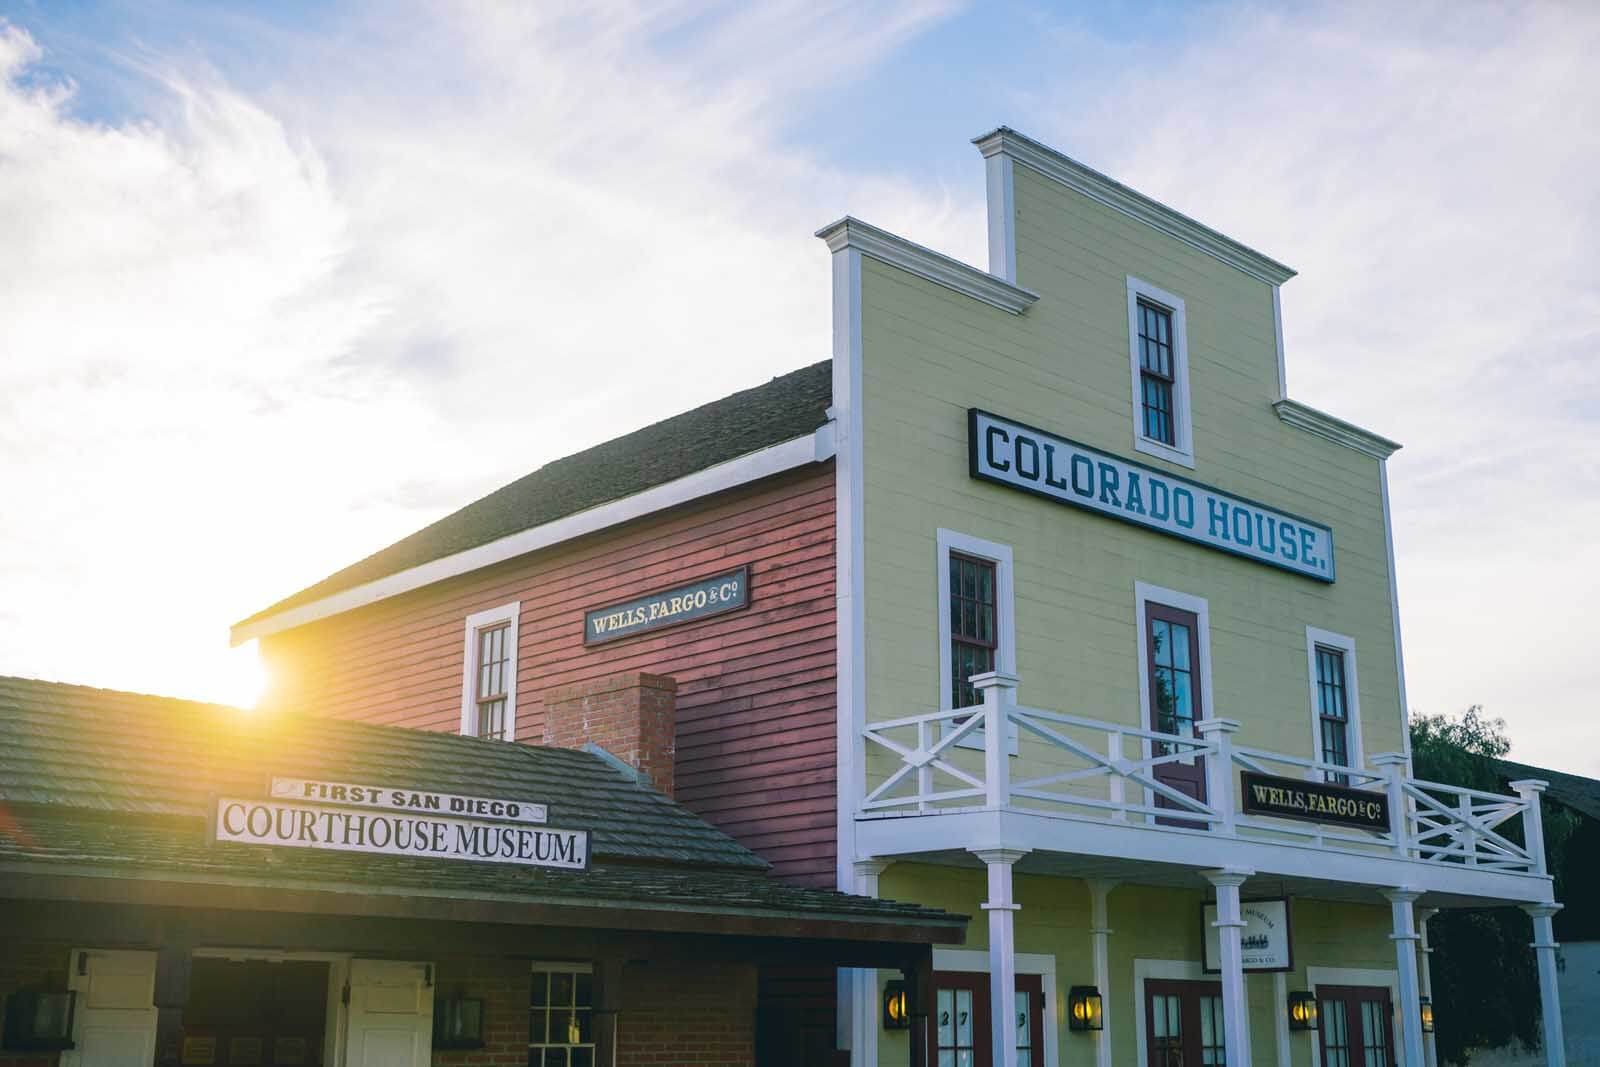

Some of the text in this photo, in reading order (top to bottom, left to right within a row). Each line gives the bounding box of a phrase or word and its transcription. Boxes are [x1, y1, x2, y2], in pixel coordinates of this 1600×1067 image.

[985, 425, 1326, 570] COLORADO HOUSE.
[592, 606, 649, 634] WELLS,
[649, 590, 706, 621] FARGO
[709, 587, 719, 604] &
[303, 781, 521, 818] FIRST SAN DIEGO
[1252, 785, 1308, 813] WELLS,
[1308, 793, 1357, 817] FARGO
[223, 803, 584, 864] COURTHOUSE MUSEUM.
